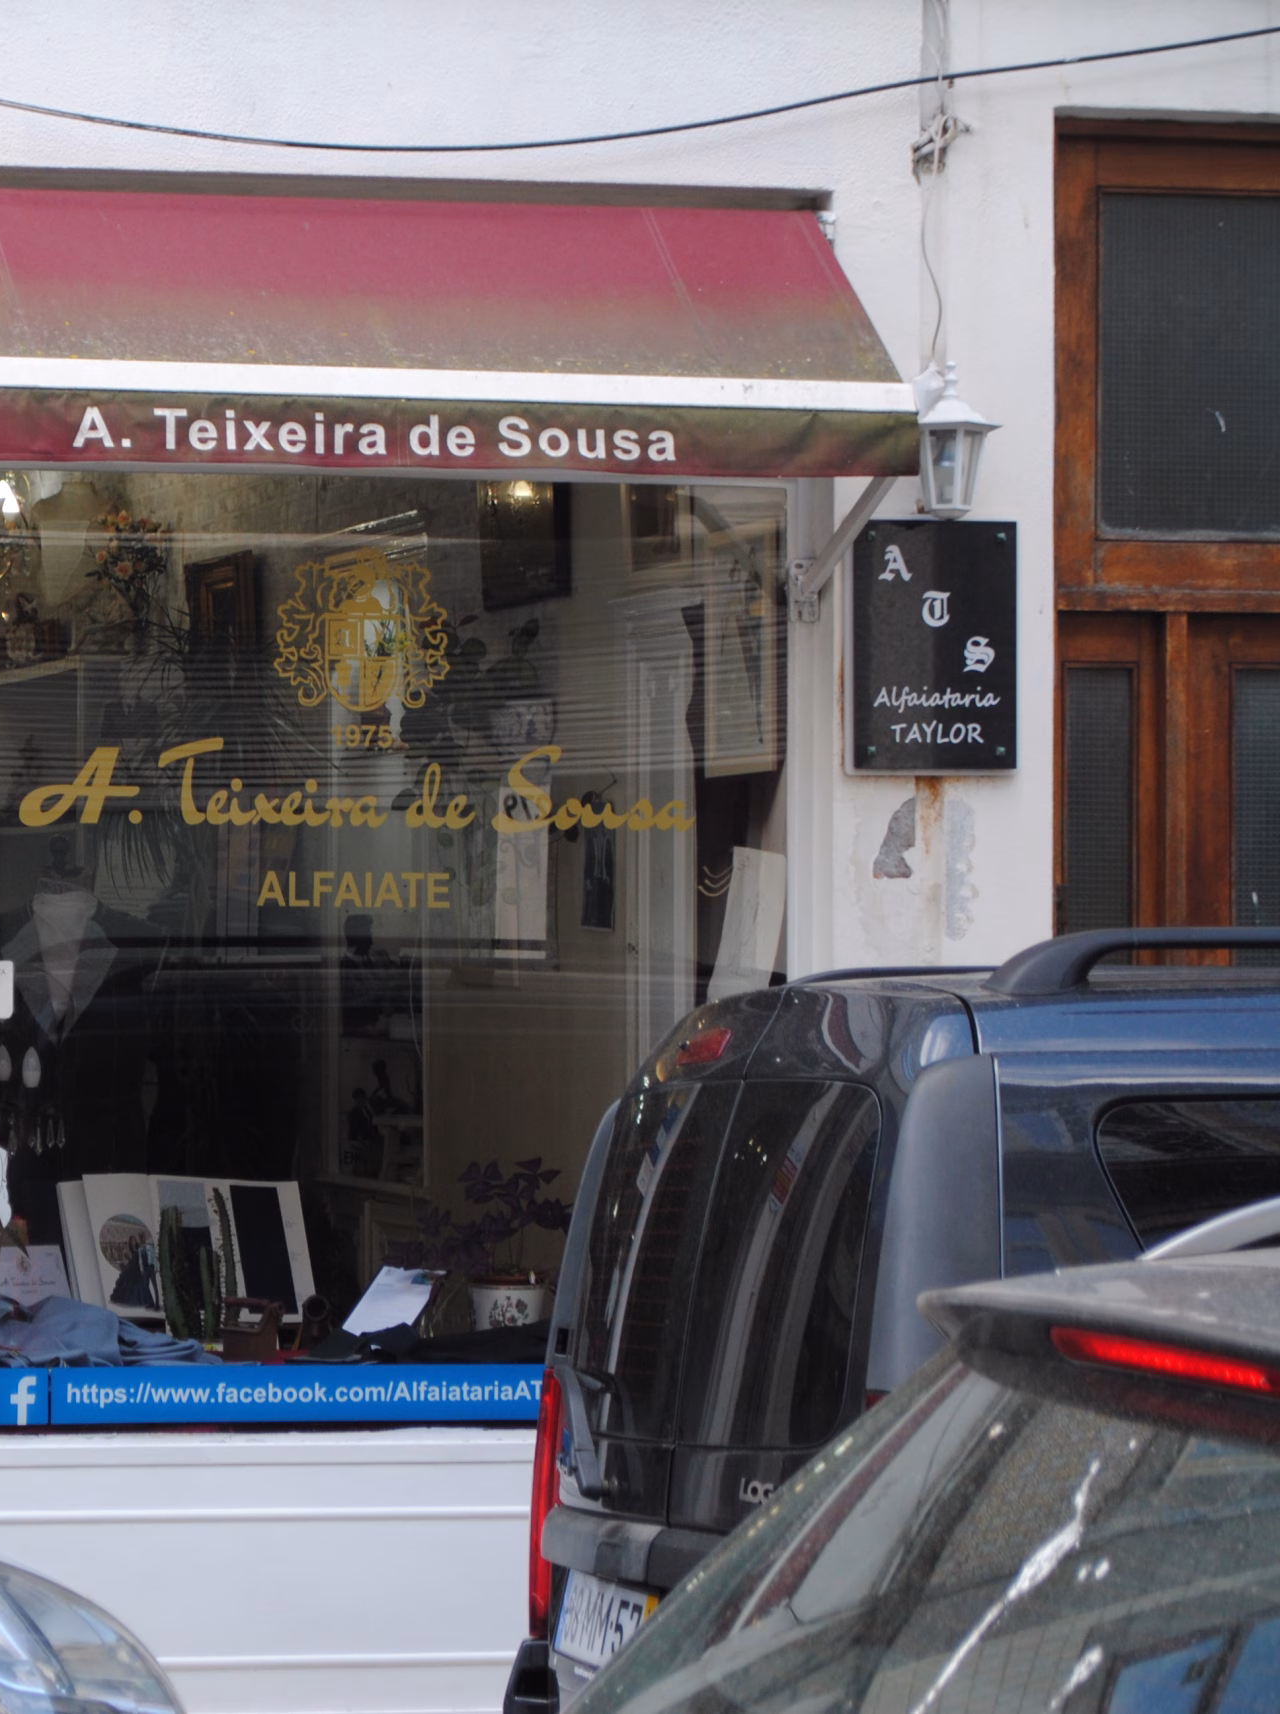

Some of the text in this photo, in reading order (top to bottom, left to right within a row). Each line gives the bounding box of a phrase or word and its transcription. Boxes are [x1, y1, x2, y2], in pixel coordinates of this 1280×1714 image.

[72, 406, 132, 448] A.
[153, 408, 387, 455] Teixeira
[409, 414, 475, 457] de
[498, 415, 676, 462] Sousa
[878, 544, 913, 582] A
[922, 590, 951, 628] T
[963, 635, 996, 673] S
[873, 686, 1001, 713] Alfaiataria
[334, 725, 393, 748] 1975
[890, 720, 985, 744] TAYLOR
[158, 737, 390, 828] Teixeira
[405, 762, 475, 829] de
[491, 744, 697, 833] Sousa
[256, 870, 450, 909] ALFAIATE
